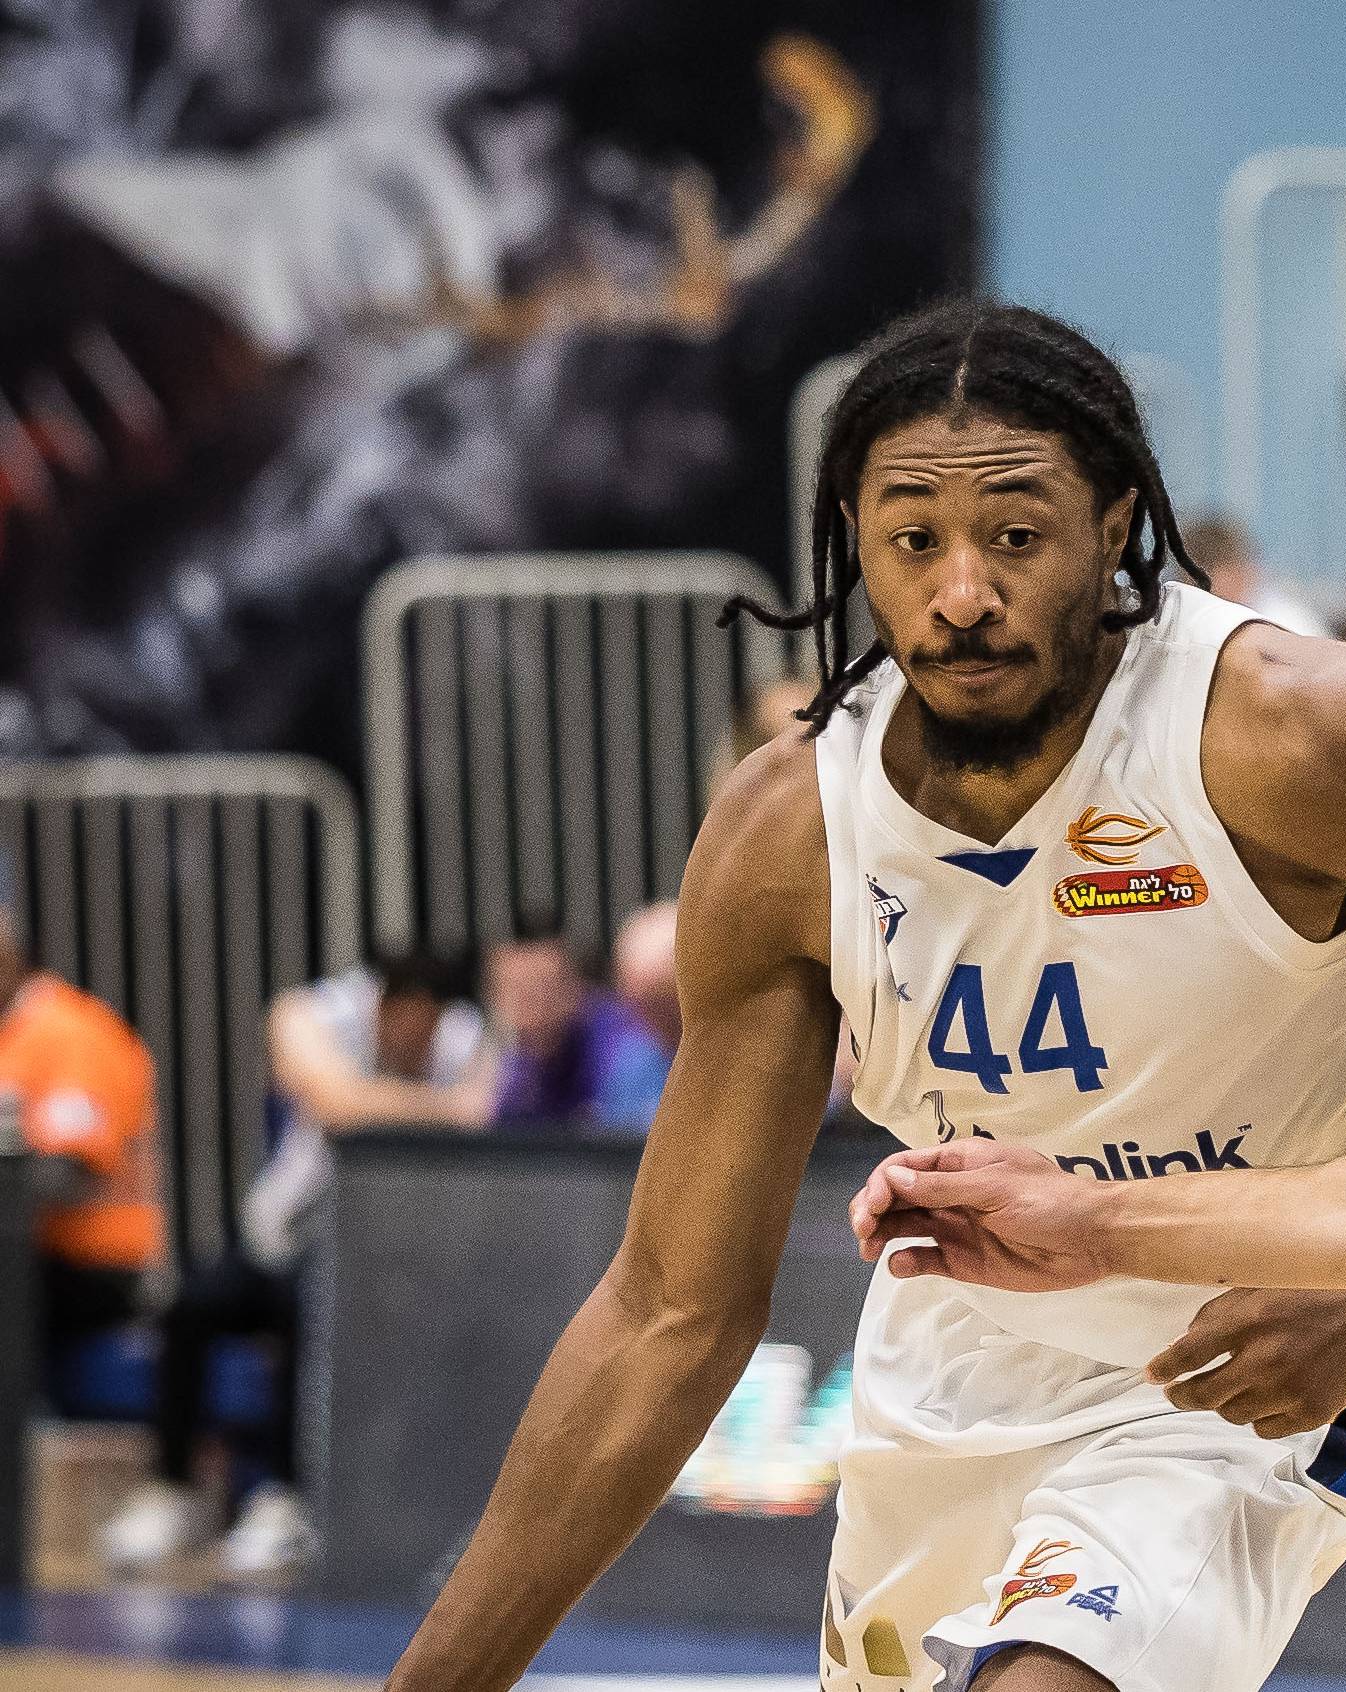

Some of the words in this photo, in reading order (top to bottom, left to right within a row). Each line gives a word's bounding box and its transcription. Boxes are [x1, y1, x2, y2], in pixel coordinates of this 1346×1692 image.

[1129, 874, 1161, 891] ליגת
[1168, 883, 1193, 900] סל
[1069, 885, 1166, 909] Winner
[927, 961, 1109, 1095] 44
